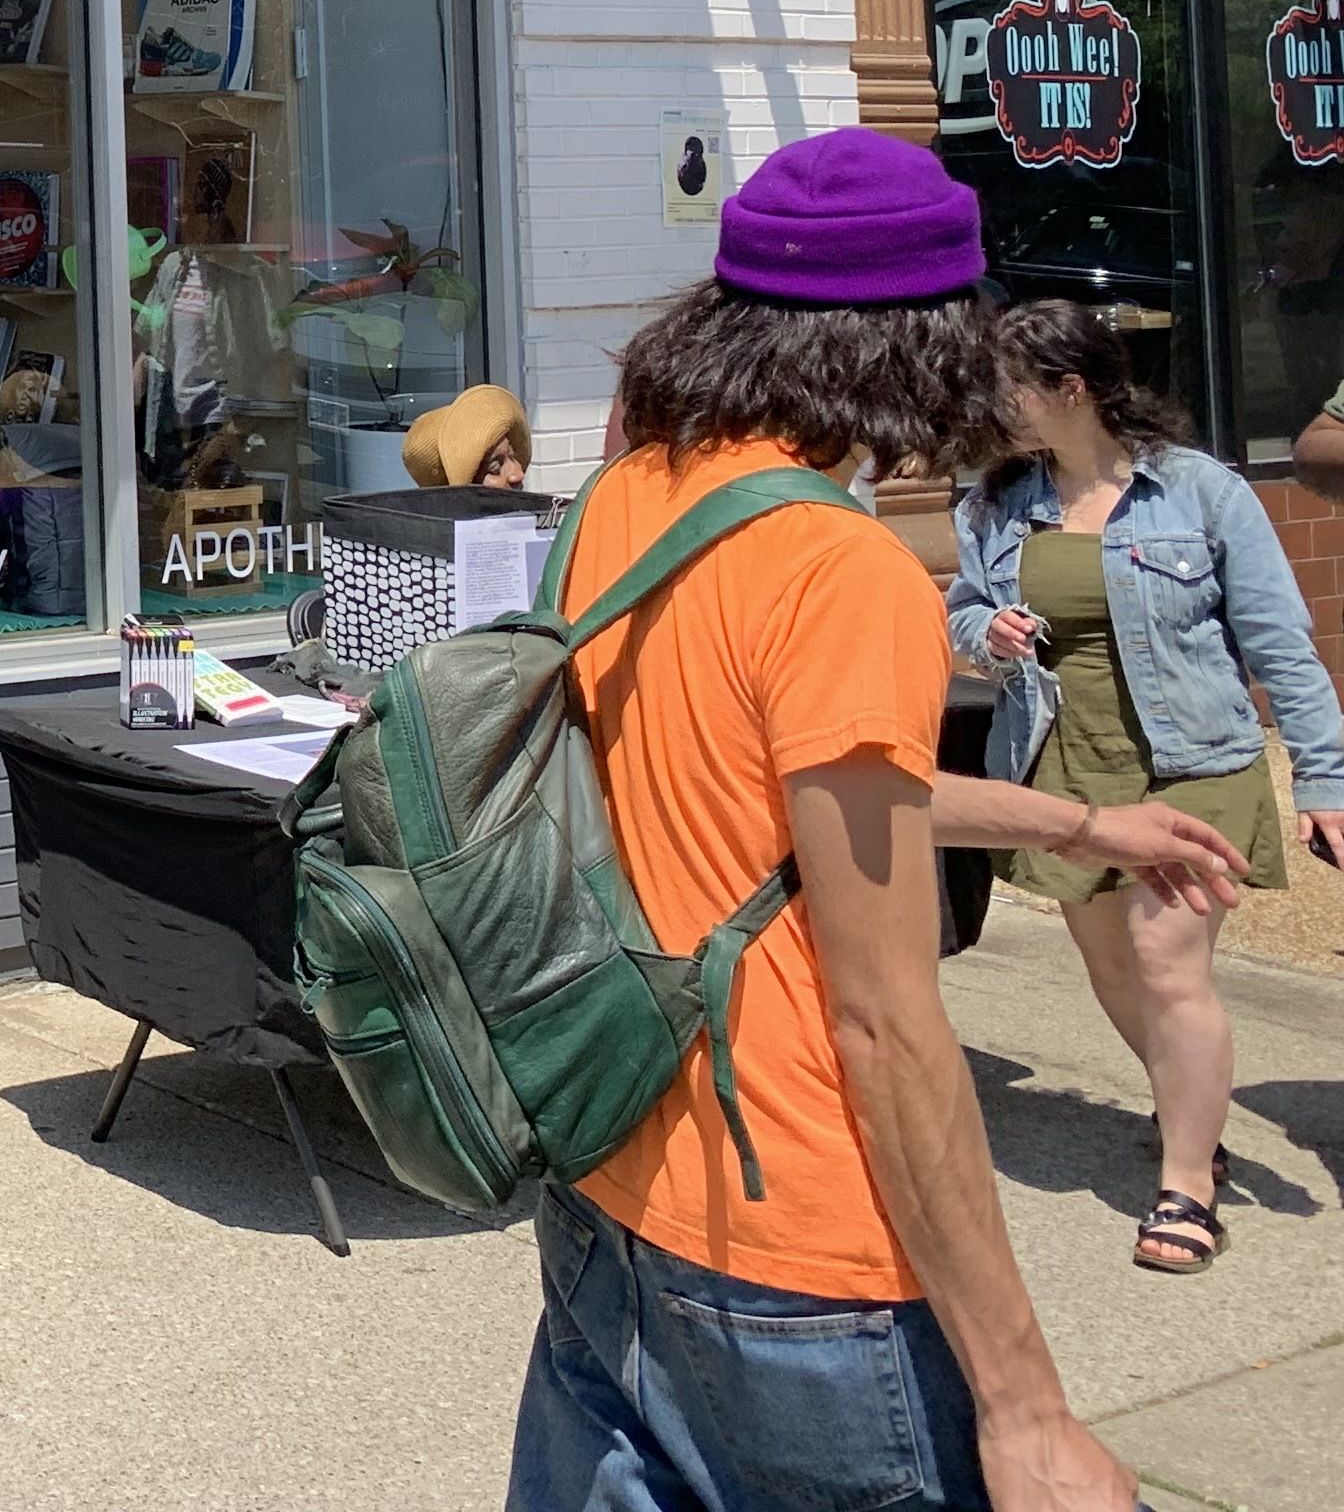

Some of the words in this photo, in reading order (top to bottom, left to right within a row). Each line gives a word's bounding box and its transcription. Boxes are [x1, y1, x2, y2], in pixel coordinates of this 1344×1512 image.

[1005, 21, 1060, 76] Oooh
[1068, 24, 1119, 77] Wee!
[1284, 28, 1332, 79] Oooh
[1039, 82, 1061, 129] IT
[1065, 82, 1091, 129] IS!
[161, 521, 324, 585] APOTH
